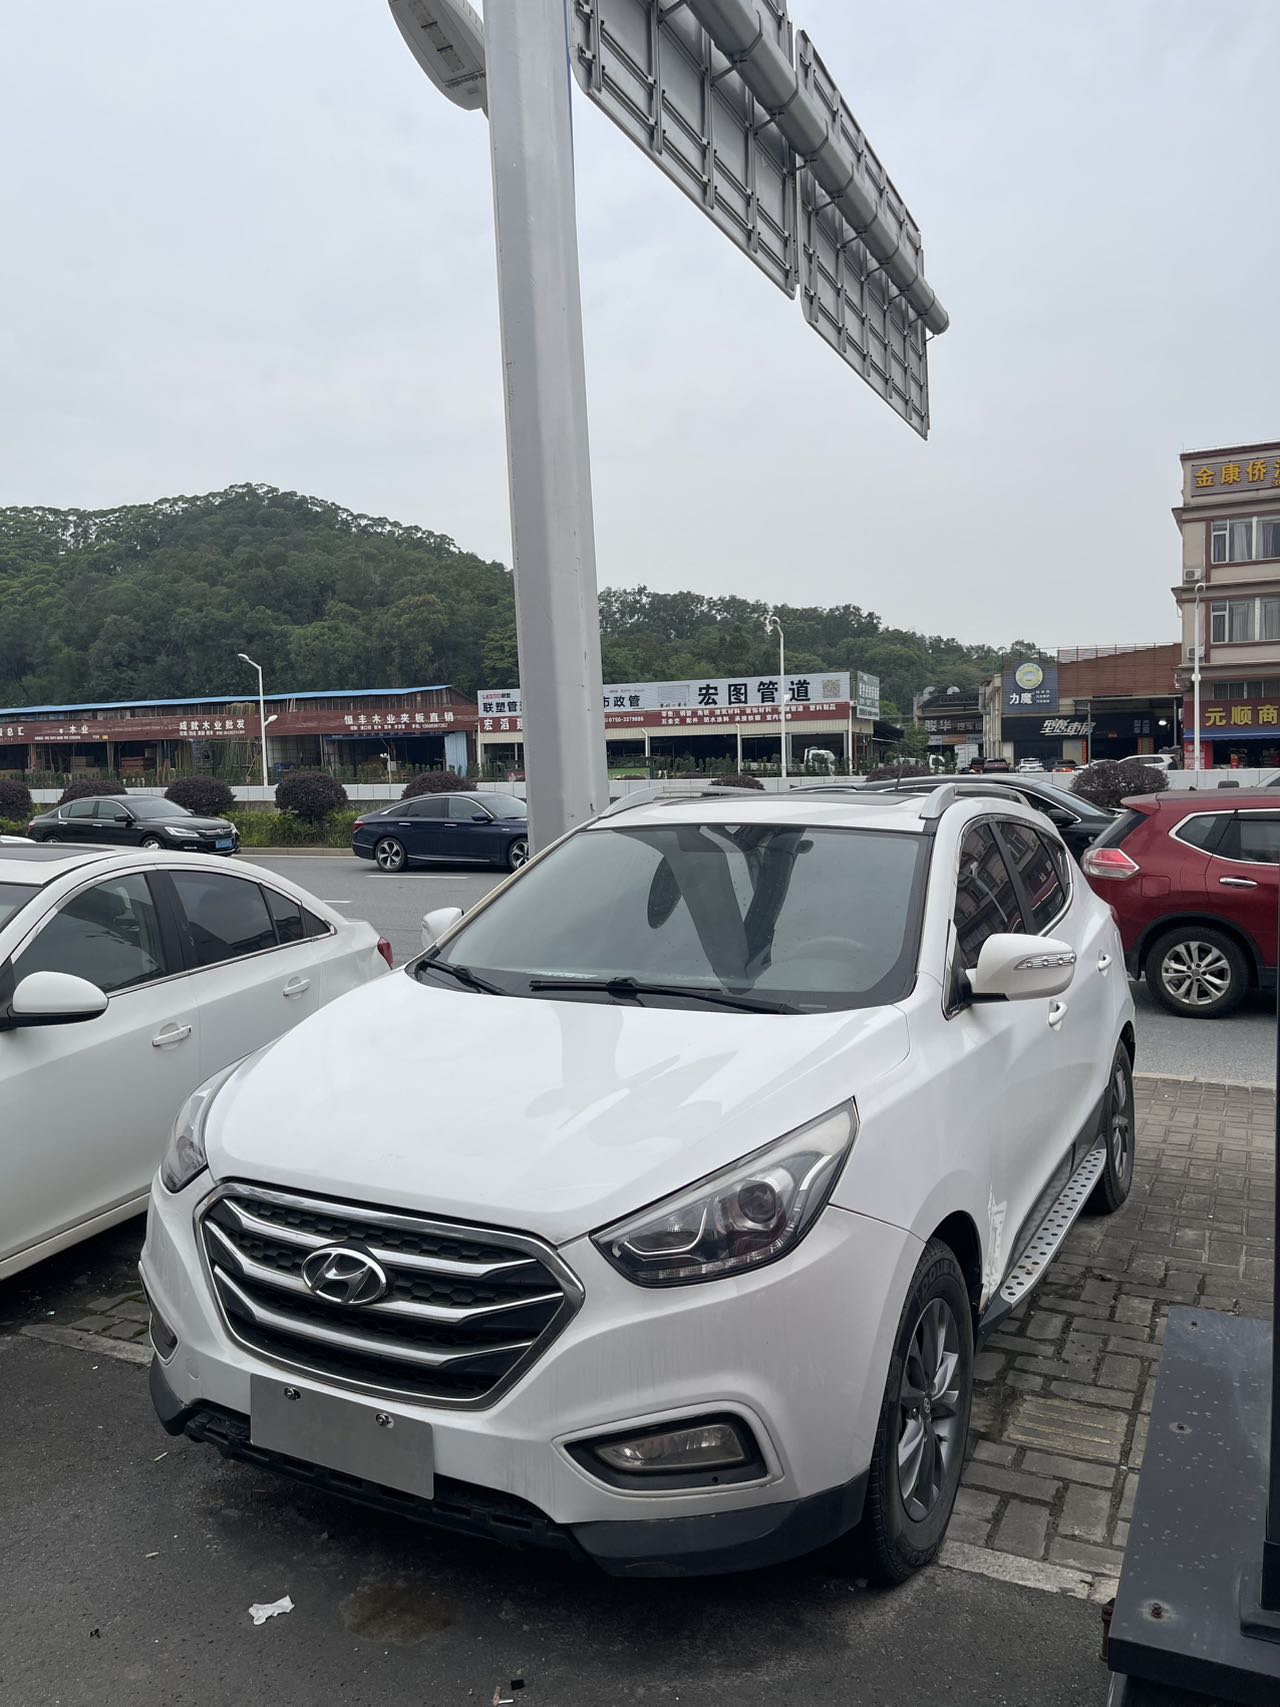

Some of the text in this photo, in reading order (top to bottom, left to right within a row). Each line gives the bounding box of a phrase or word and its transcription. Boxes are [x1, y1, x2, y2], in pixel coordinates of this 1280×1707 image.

[1194, 458, 1280, 488] 金康侨
[698, 679, 811, 705] 宏图管道
[1009, 692, 1033, 704] 力魔
[483, 701, 523, 713] 联塑管
[603, 695, 640, 708] 市政管
[344, 711, 454, 725] 恒丰木业夹板直销
[1205, 704, 1279, 727] 元顺商
[179, 719, 245, 730] 成就木业批发
[0, 726, 24, 737] 总汇
